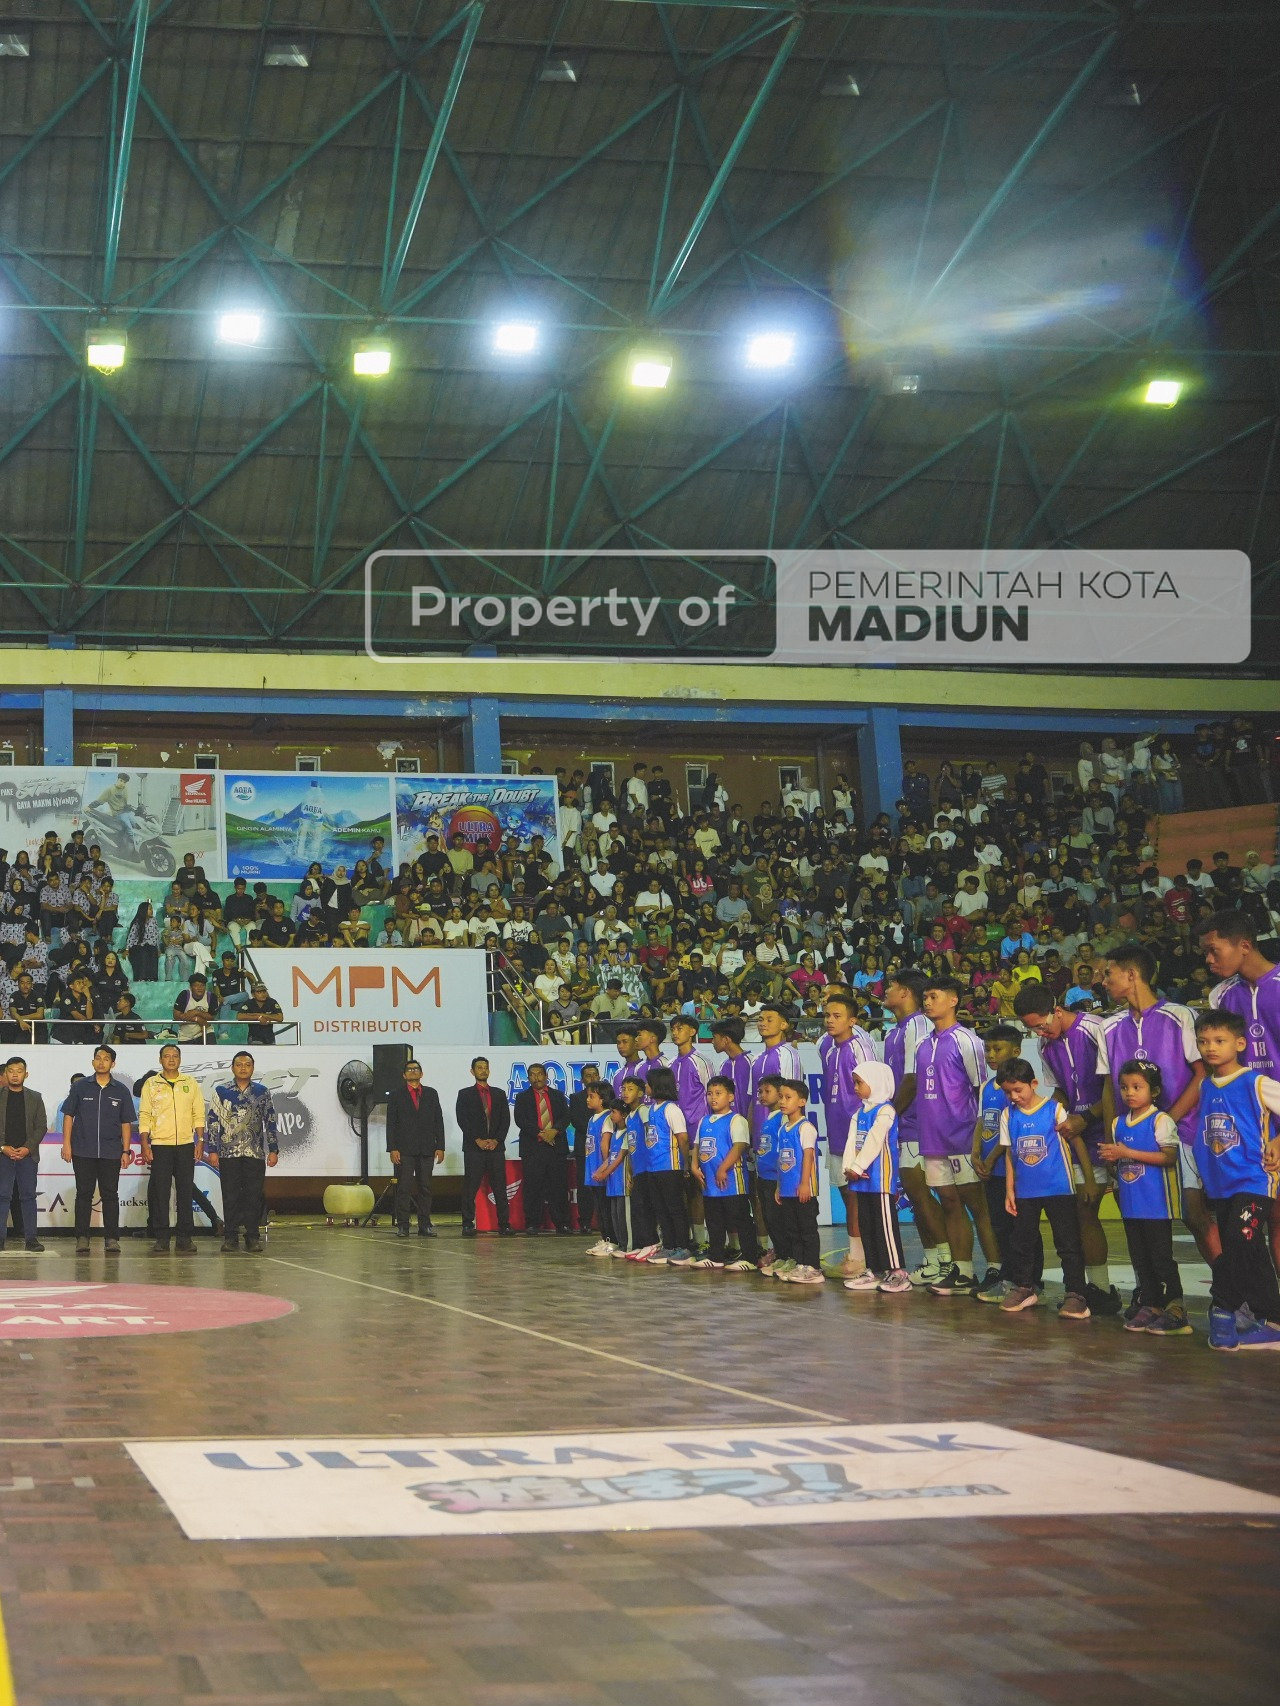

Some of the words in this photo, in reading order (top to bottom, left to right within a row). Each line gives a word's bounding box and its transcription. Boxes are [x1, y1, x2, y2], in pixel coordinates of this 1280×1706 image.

[234, 786, 252, 794] AQUA
[411, 790, 473, 811] BREAK
[472, 793, 490, 803] THE
[490, 788, 541, 806] DOUBT
[303, 804, 322, 815] AQUA
[458, 821, 495, 832] ULTRA
[292, 966, 442, 1008] MPM
[314, 1020, 422, 1033] DISTRIBUTOR
[1252, 1042, 1266, 1056] 18
[926, 1078, 934, 1091] 19
[203, 1445, 652, 1471] ULTRA
[664, 1433, 1023, 1460] MILK
